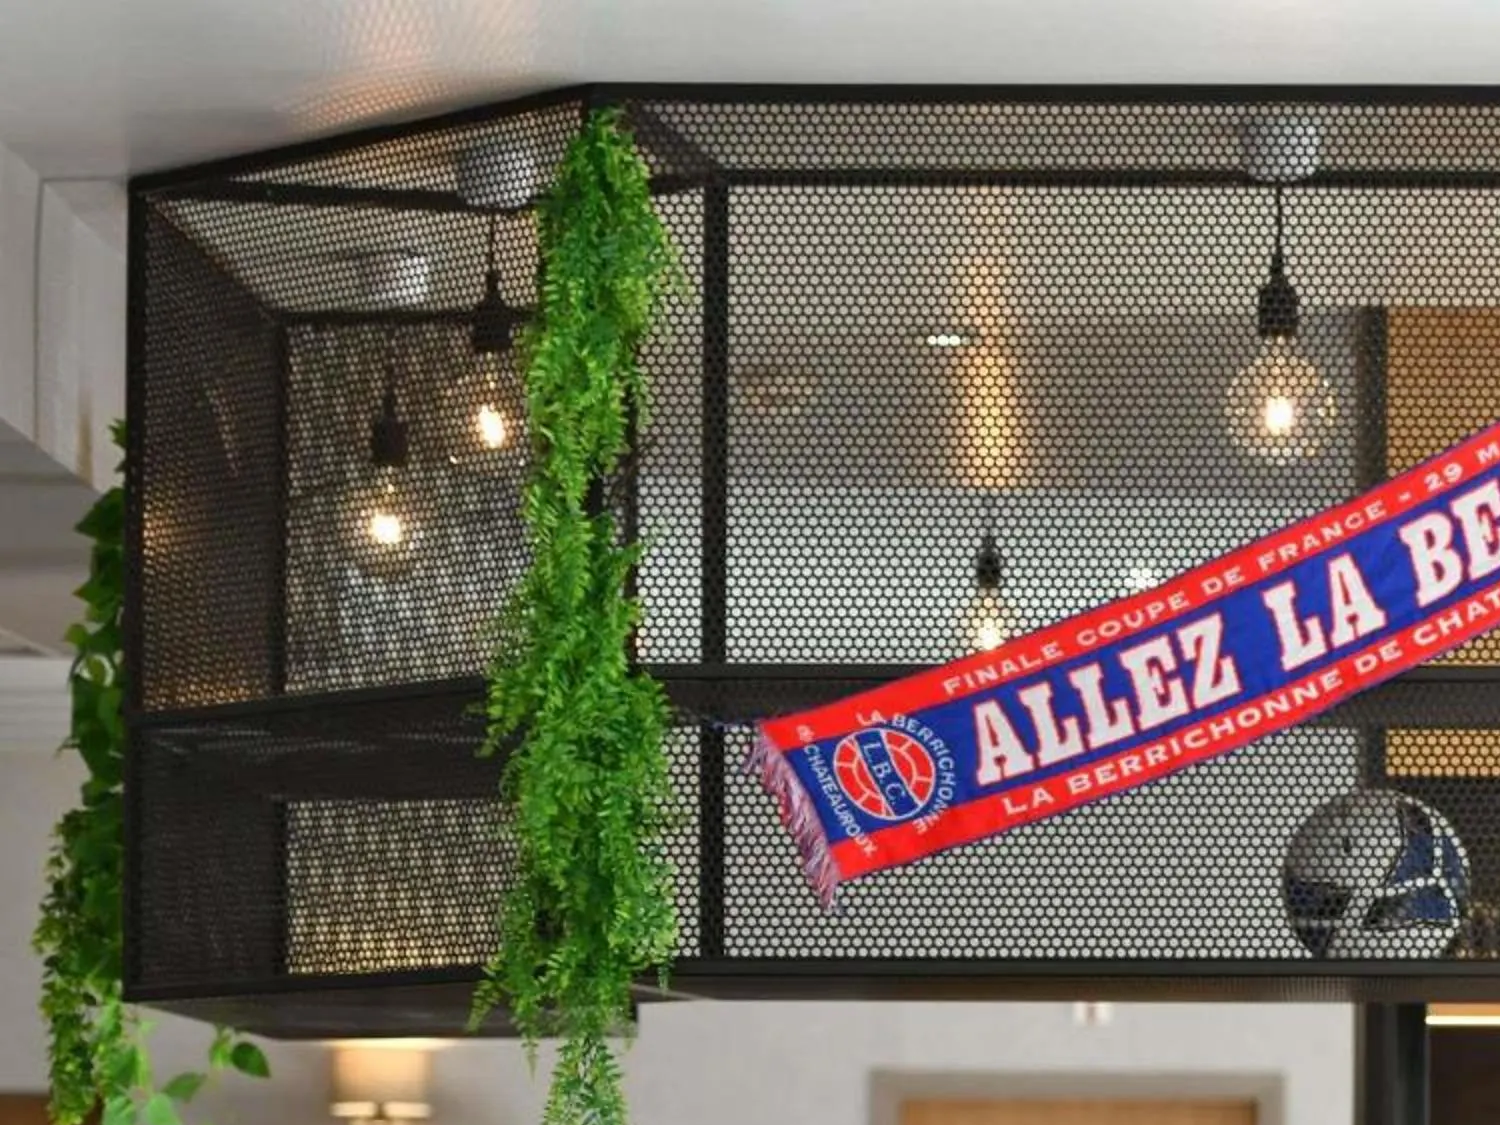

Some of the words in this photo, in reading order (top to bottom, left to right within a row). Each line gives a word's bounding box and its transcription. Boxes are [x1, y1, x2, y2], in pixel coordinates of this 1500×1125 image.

[943, 641, 1064, 695] FINALE
[1076, 590, 1190, 647] COUPE
[1201, 566, 1246, 594] DE
[1257, 501, 1387, 570] FRANCE
[1424, 462, 1464, 491] 29
[975, 612, 1242, 787] ALLEZ
[1262, 553, 1387, 672] LA
[1002, 786, 1055, 816] LA
[1068, 669, 1343, 795] BERRICHONNE
[1353, 643, 1403, 675] DE
